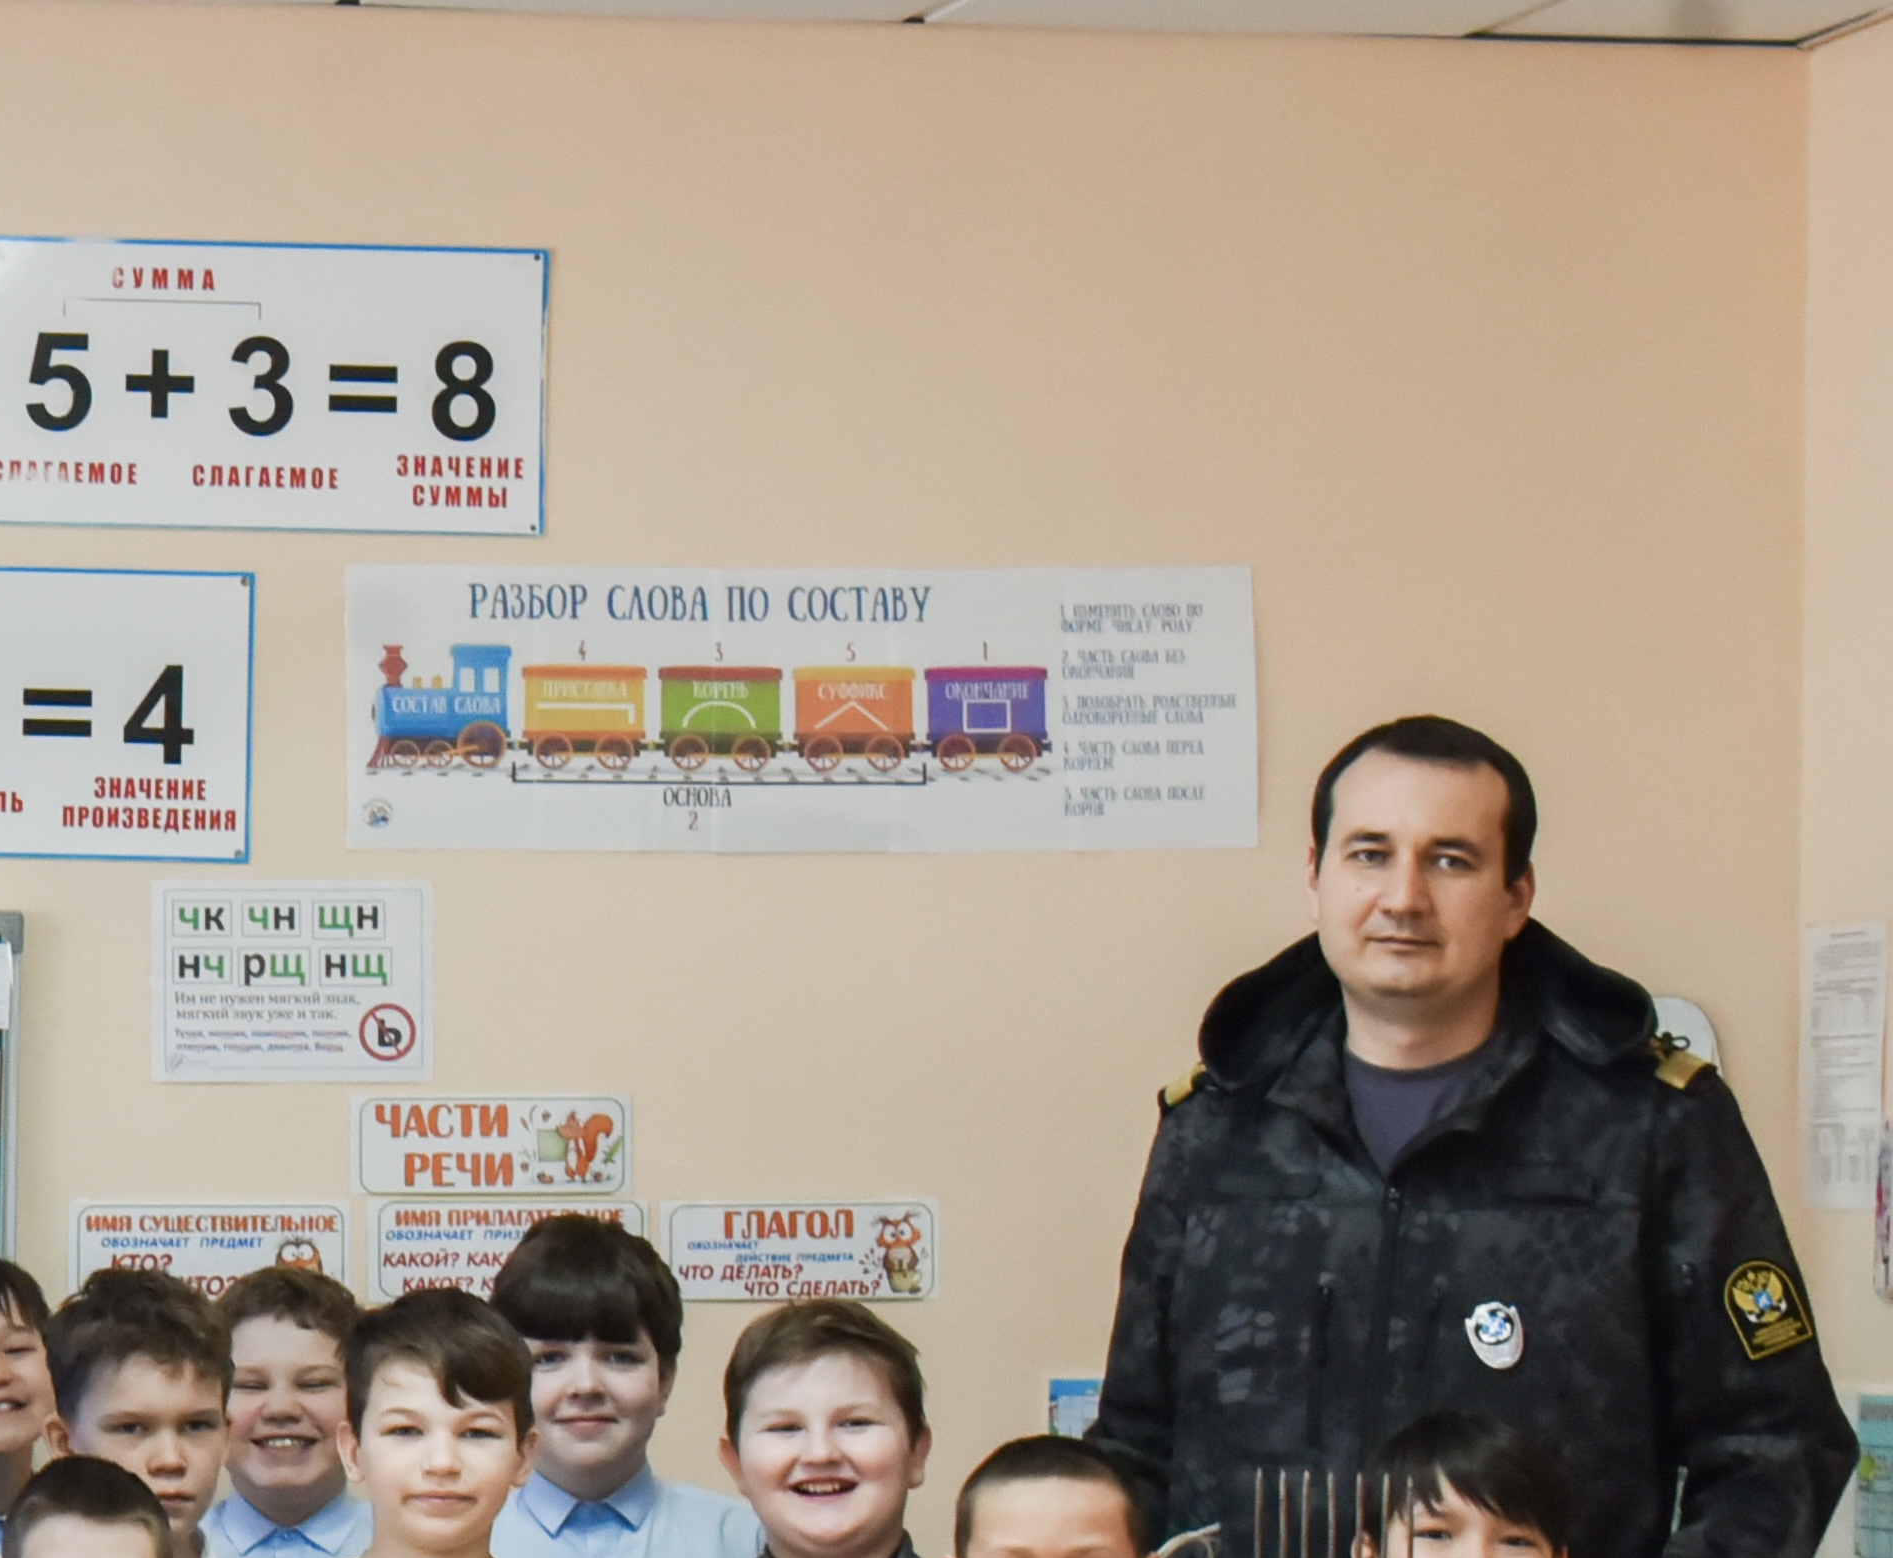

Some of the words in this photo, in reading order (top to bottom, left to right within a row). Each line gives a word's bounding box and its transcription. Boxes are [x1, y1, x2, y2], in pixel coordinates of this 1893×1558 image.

[112, 267, 217, 291] СУММА
[25, 332, 93, 432] 5
[228, 336, 294, 437] 3
[431, 341, 497, 442] 8
[192, 464, 341, 489] СЛАГАЕМОЕ
[396, 455, 525, 480] ЗНАЧЕНИЕ
[412, 485, 509, 509] СУММЫ
[469, 583, 588, 620] РАЗБОР
[607, 586, 709, 622] СЛОВА
[726, 586, 770, 622] ПО
[787, 586, 932, 623] СОСТАВУ
[714, 641, 724, 663] 3
[846, 641, 857, 662] 5
[693, 680, 750, 699] КОРЕНЬ
[817, 681, 887, 701] СУФФИКС
[123, 664, 195, 766] 4
[392, 696, 448, 715] СОСТАВ
[93, 776, 207, 802] ЗНАЧЕНИЕ
[663, 787, 732, 808] ОСНОВА
[62, 806, 237, 834] ПРОИЗВЕДЕНИЯ
[687, 811, 699, 831] 2
[179, 907, 226, 931] чк
[248, 906, 295, 931] чн
[318, 906, 379, 936] щн
[178, 954, 225, 979] нч
[244, 953, 306, 987] рщ
[325, 954, 388, 986] нщ
[375, 1104, 509, 1140] ЧАСТИ
[404, 1152, 514, 1188] РЕЧИ
[86, 1215, 132, 1233] ИМЯ
[139, 1214, 339, 1235] СУЩЕСТВИТЕЛЬНОЕ
[395, 1209, 442, 1228] ИМЯ
[724, 1208, 855, 1240] ГЛАГОЛ
[101, 1236, 191, 1249] ОБОЗНАЧАЕТ
[200, 1237, 264, 1250] ПРЕДМЕТ
[385, 1229, 475, 1242] ОБОЗНАЧАЕТ
[483, 1229, 527, 1242] ПРИЗ
[687, 1240, 759, 1250] ОБОЗНАЧАЕТ
[383, 1248, 461, 1269] КАКОЙ?
[735, 1252, 792, 1264] ДЕЙСТВИЕ
[796, 1252, 855, 1264] ПРЕДМЕТА
[679, 1264, 715, 1281] ЧТО
[721, 1263, 804, 1283] ДЕЛАТЬ?
[744, 1280, 780, 1297] ЧТО
[786, 1279, 882, 1298] СДЕЛАТЬ?
